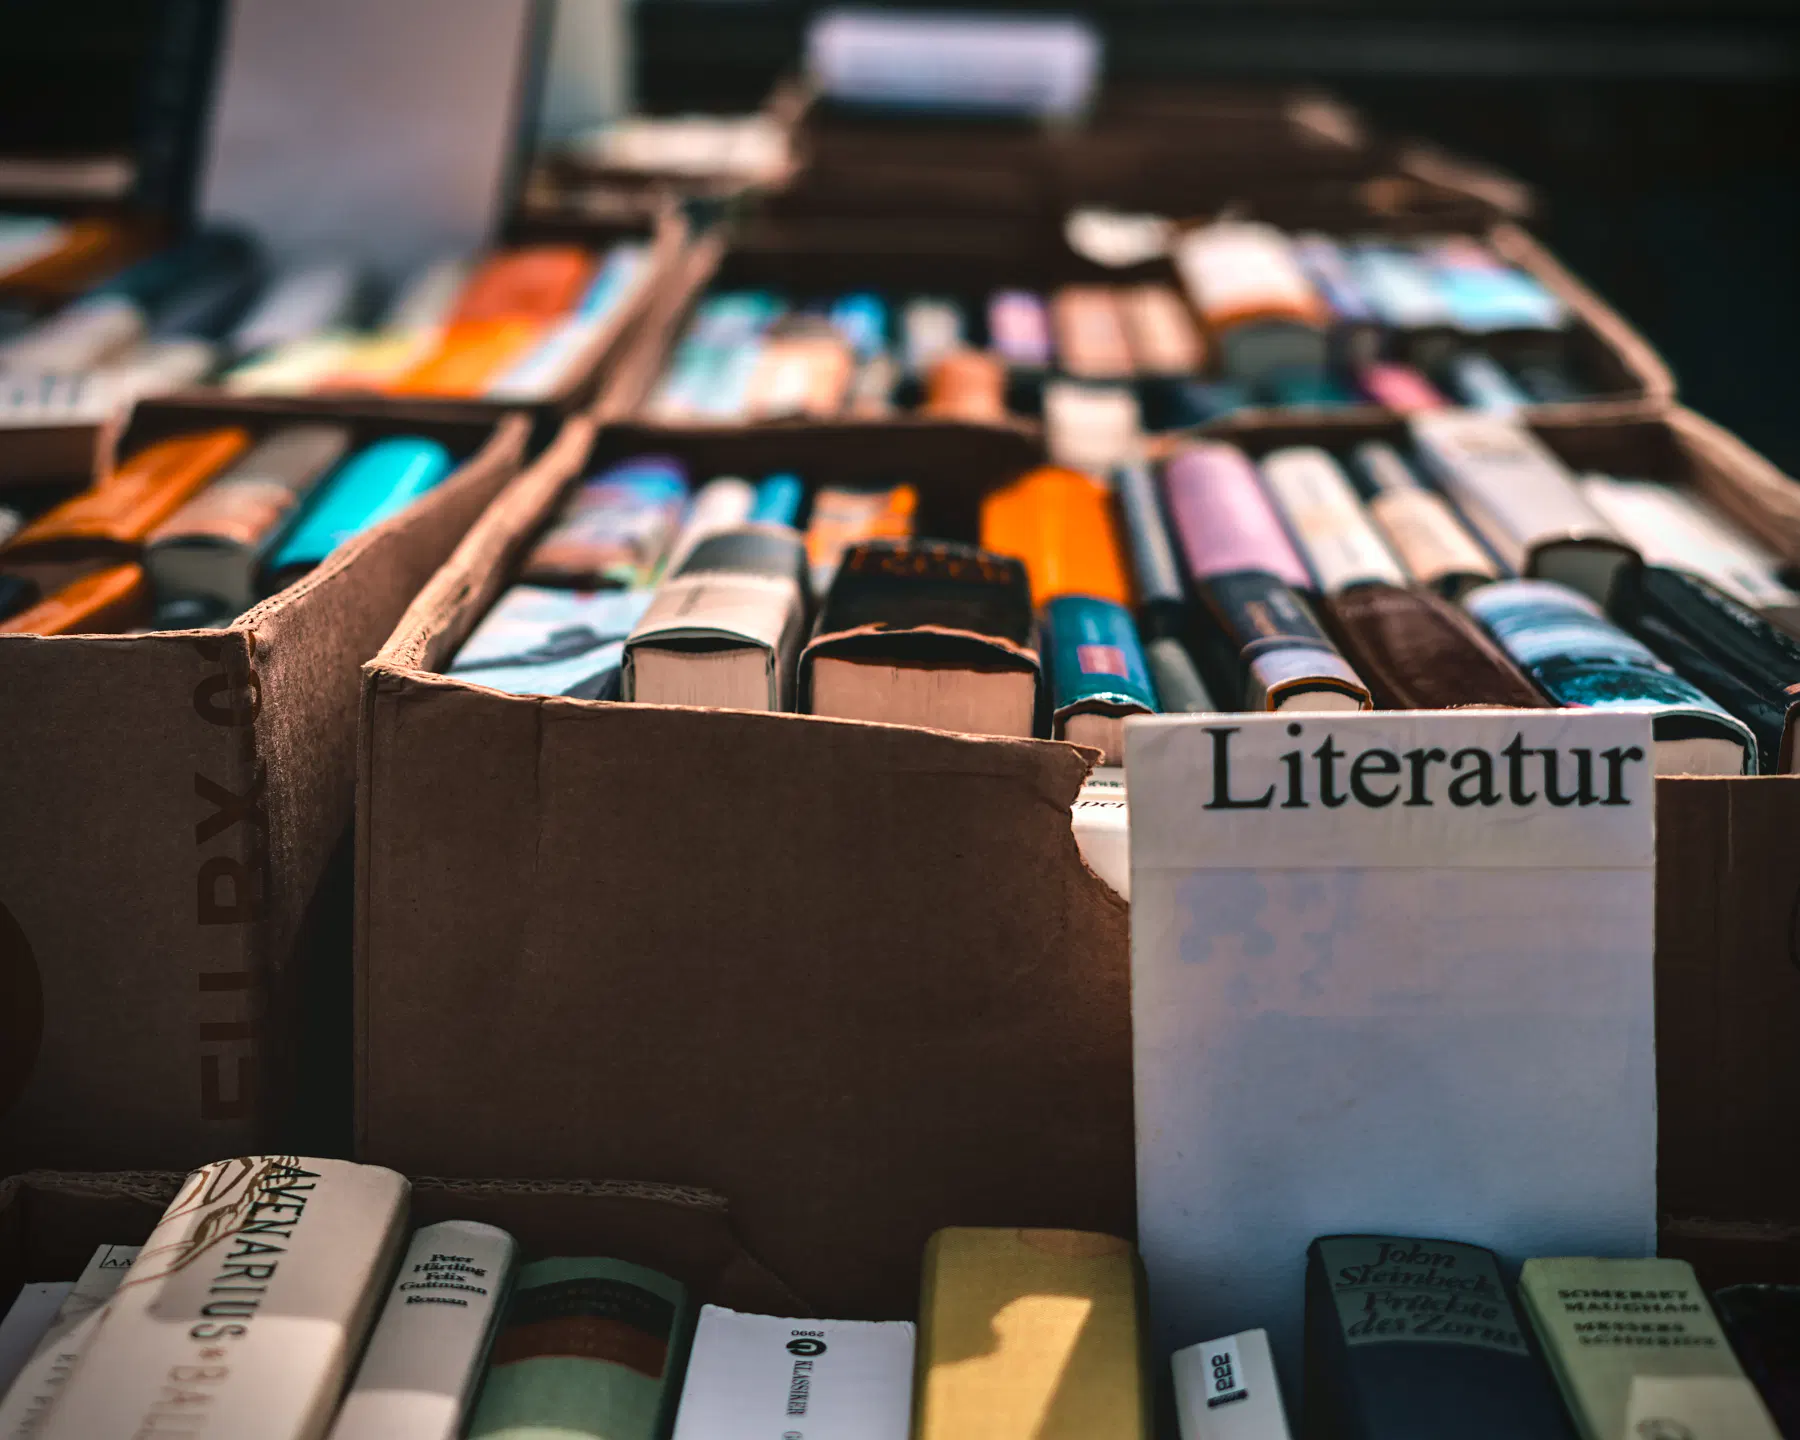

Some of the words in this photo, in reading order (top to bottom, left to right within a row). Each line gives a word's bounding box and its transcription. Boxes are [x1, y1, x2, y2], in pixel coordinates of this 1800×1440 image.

[1203, 722, 1644, 808] Literatur
[188, 1162, 322, 1341] AVENARIUS
[430, 1253, 474, 1263] Peter
[1376, 1242, 1456, 1268] John
[413, 1262, 488, 1277] Härtling
[425, 1272, 467, 1281] Felix
[400, 1281, 488, 1296] Guttmann
[1335, 1266, 1498, 1299] Steinbeck
[406, 1295, 468, 1307] Roman
[1557, 1287, 1689, 1300] SOMERSET
[1564, 1301, 1702, 1314] MAUGHAM
[790, 1329, 825, 1338] 2990
[787, 1360, 814, 1417] KLASSIKER
